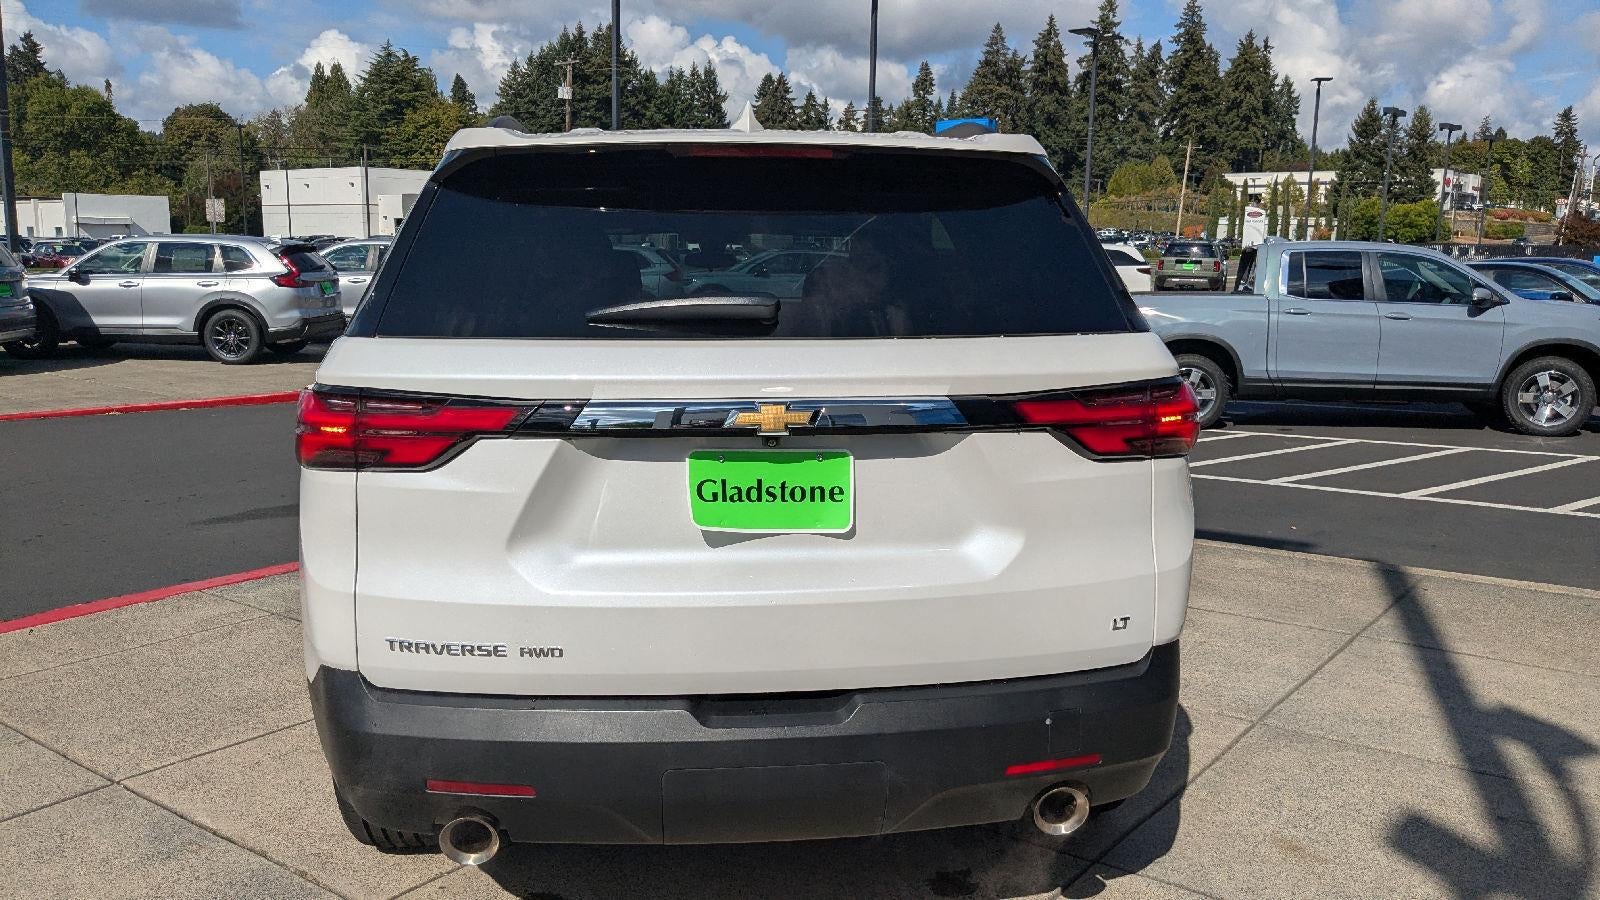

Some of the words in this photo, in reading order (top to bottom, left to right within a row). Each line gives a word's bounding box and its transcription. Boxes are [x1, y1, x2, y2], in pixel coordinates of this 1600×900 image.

[696, 478, 845, 503] Gladstone
[1112, 616, 1131, 631] LT
[385, 637, 507, 657] TRAVERSE
[519, 645, 564, 659] AWD
